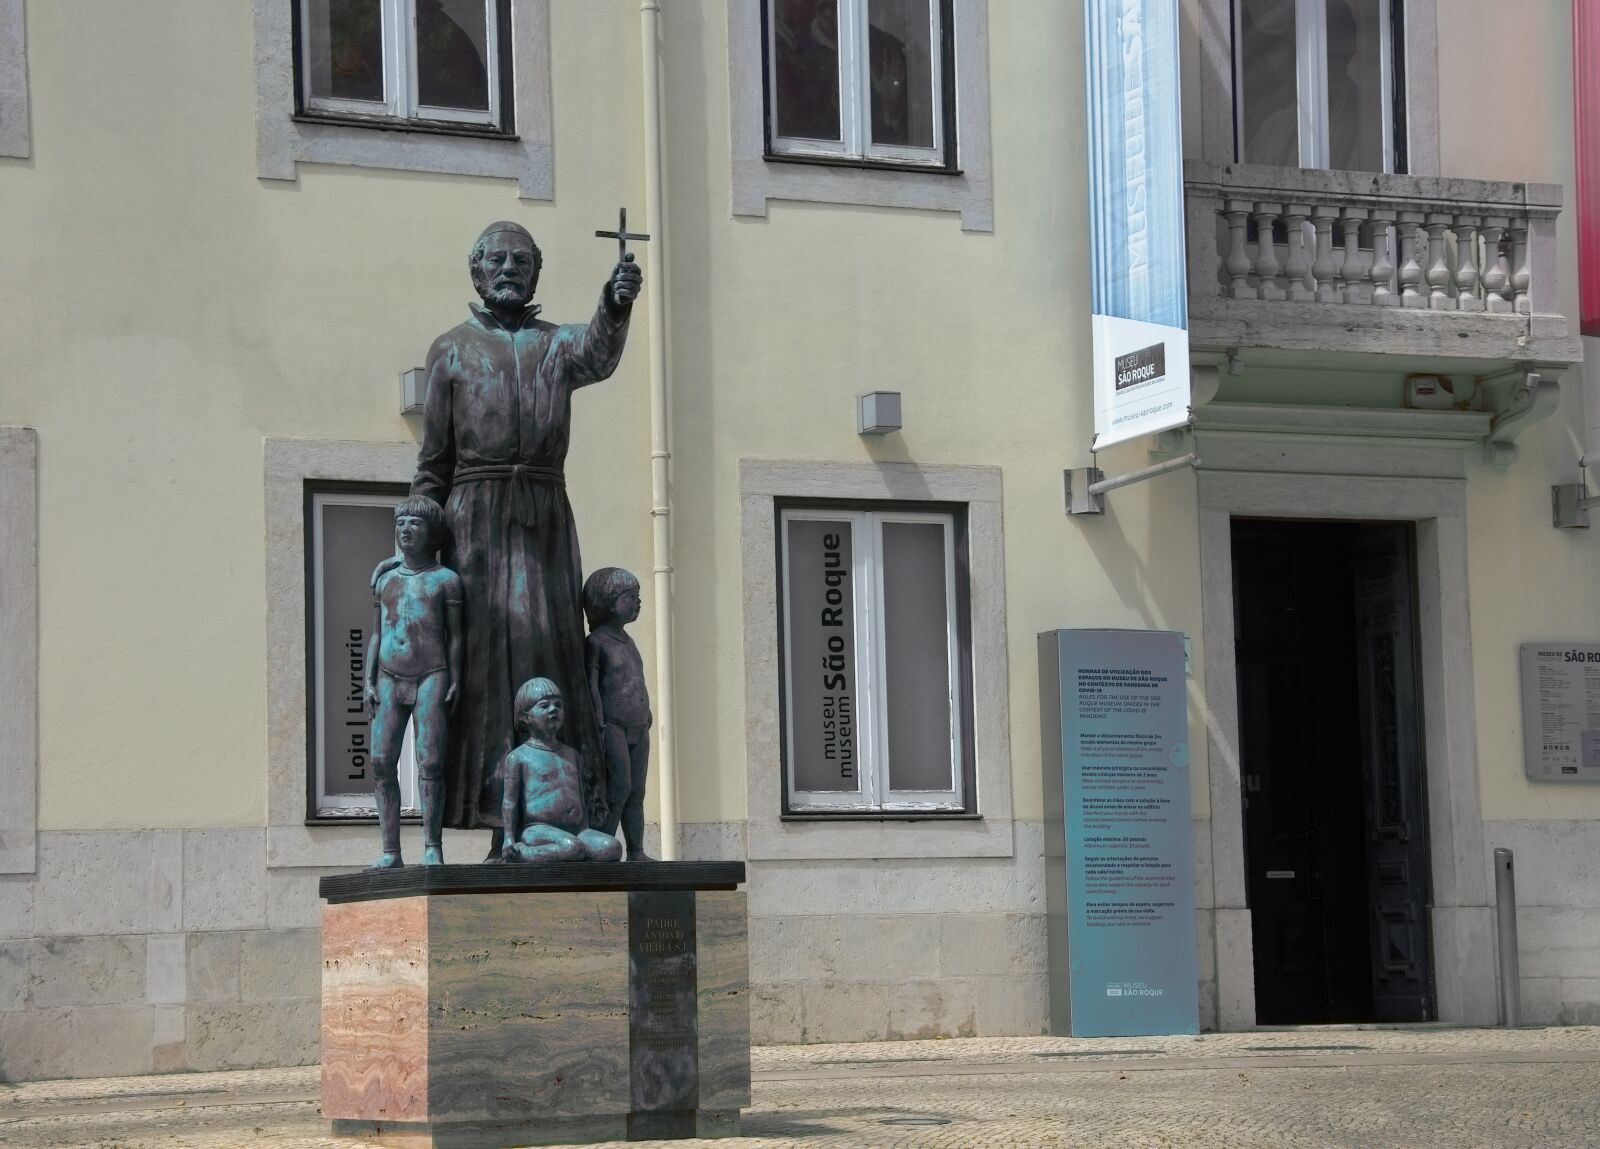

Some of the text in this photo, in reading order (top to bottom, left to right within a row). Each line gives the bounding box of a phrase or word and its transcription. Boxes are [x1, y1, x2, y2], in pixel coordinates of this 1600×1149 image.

[1117, 354, 1138, 371] MUSEU
[1118, 363, 1155, 385] SÃO ROQUE
[821, 533, 847, 691] São Roque
[345, 629, 364, 713] Livraria
[1564, 649, 1585, 663] SÃO
[822, 696, 836, 760] museu
[839, 696, 852, 778] museum
[348, 733, 369, 780] Loja
[1123, 988, 1138, 996] SÃO
